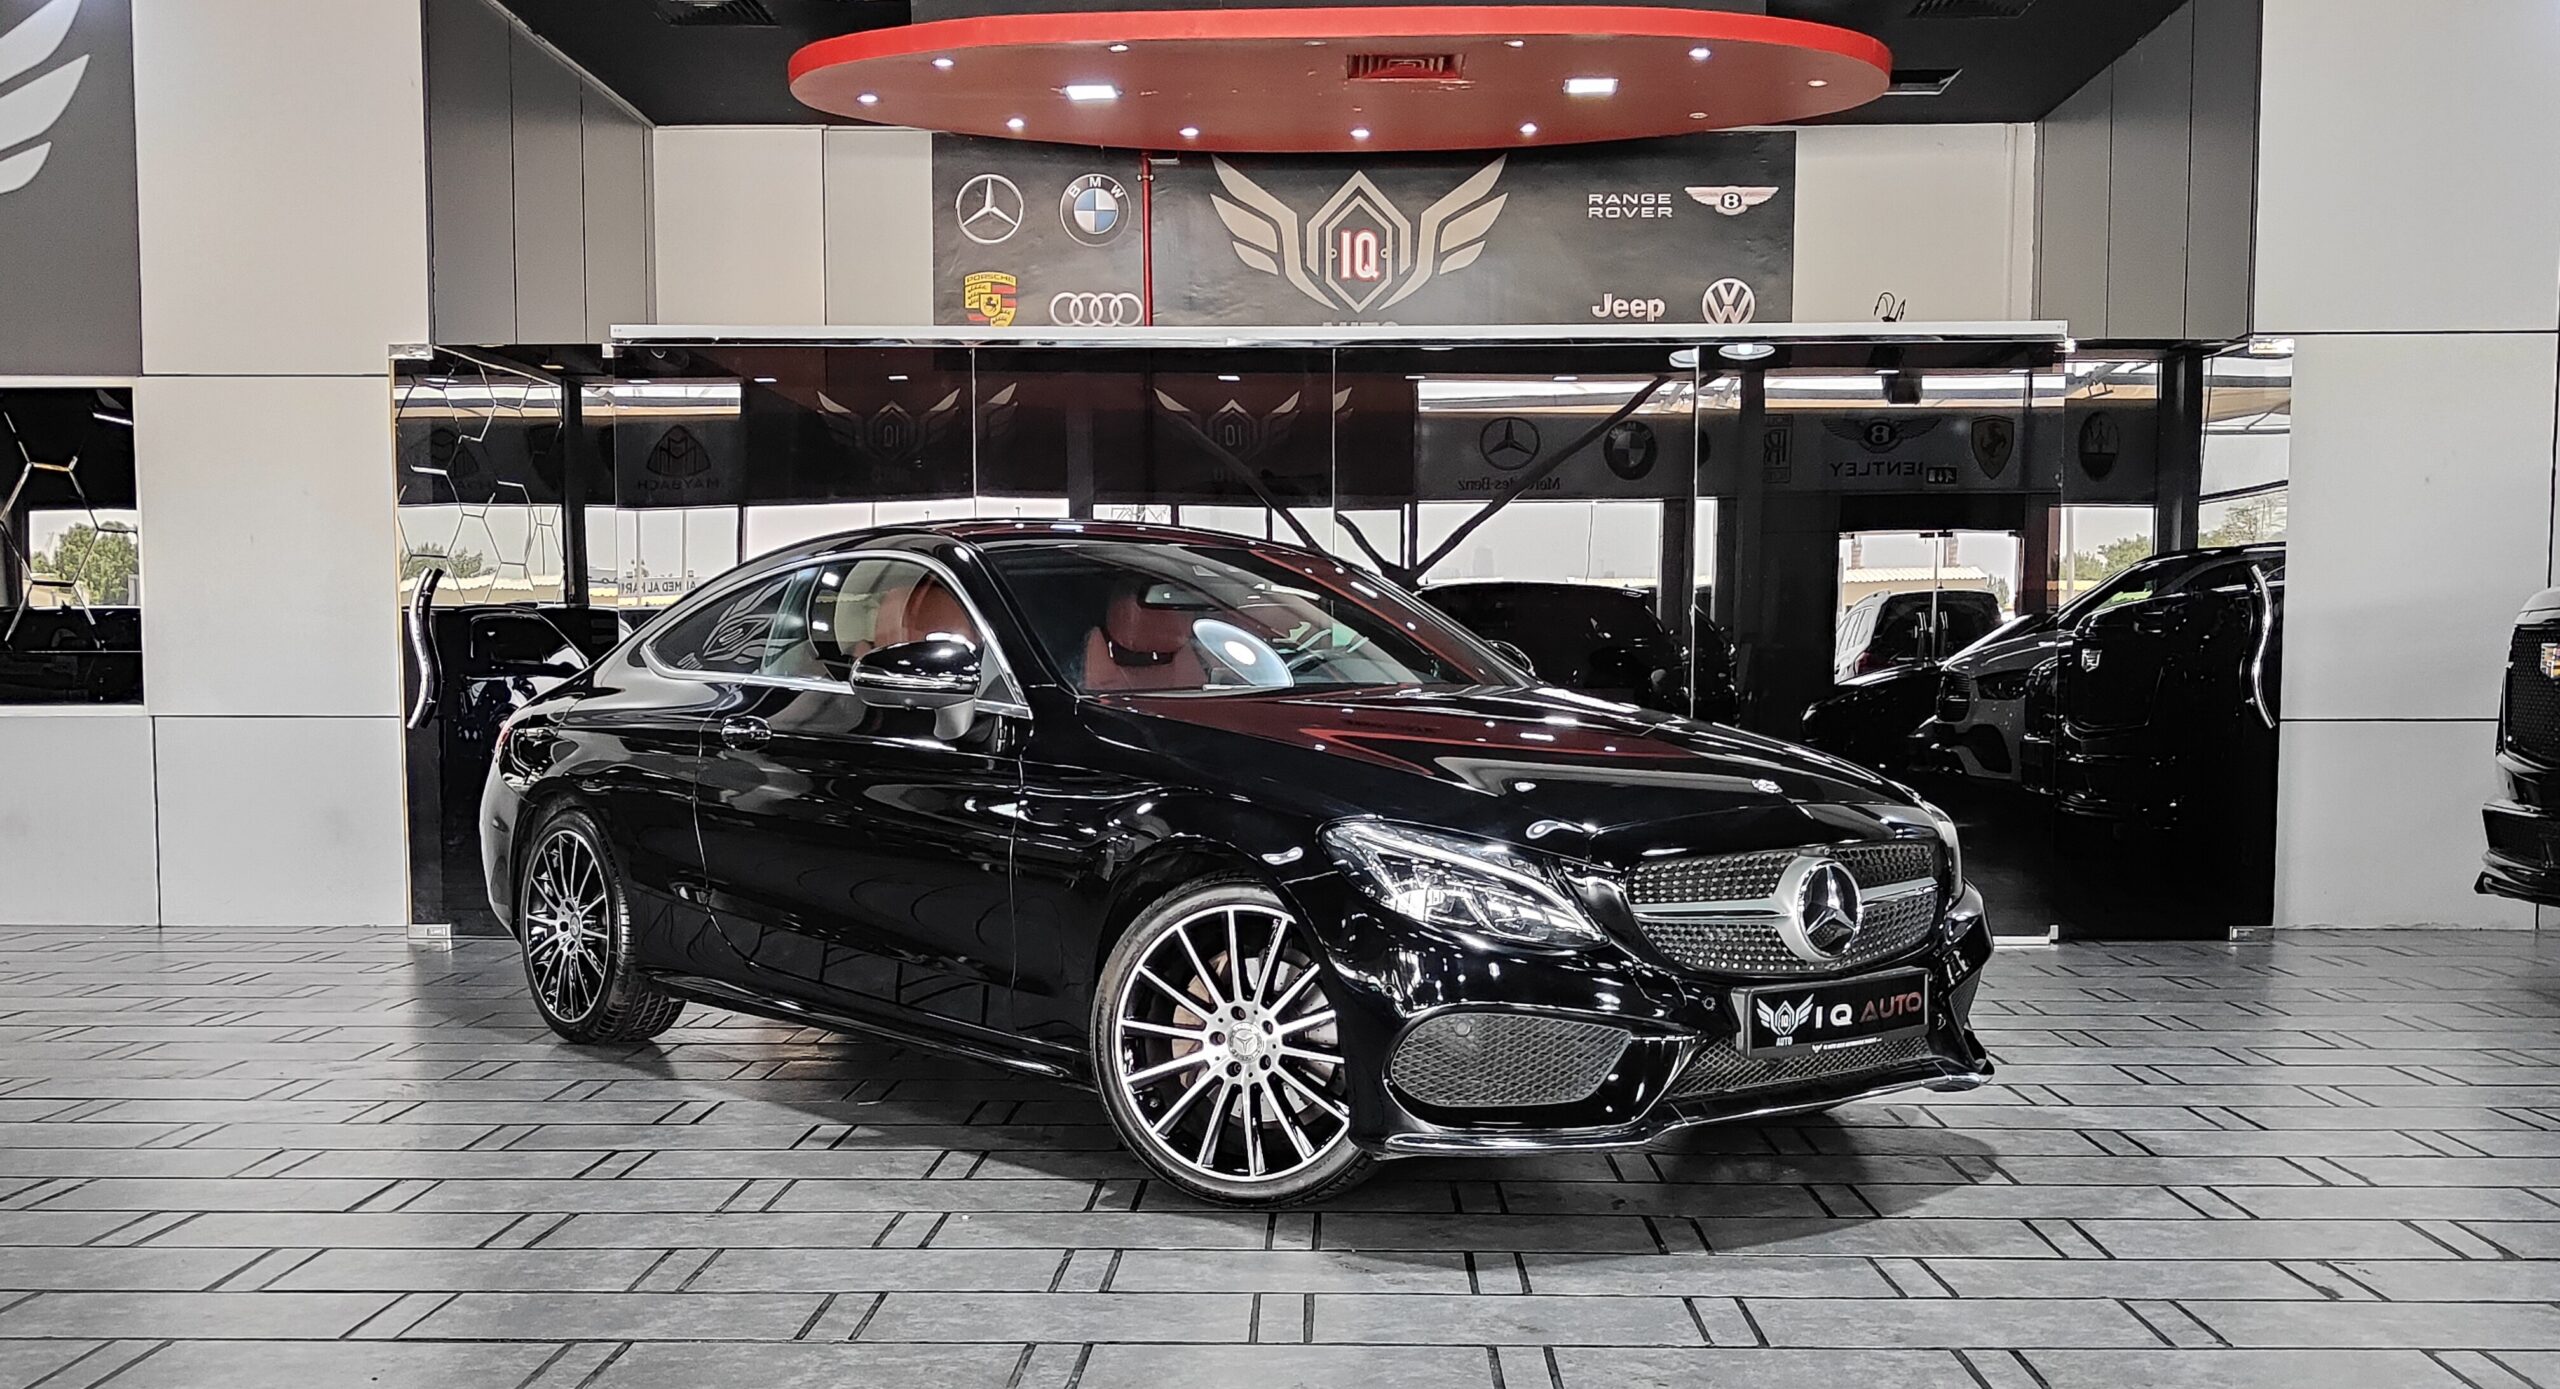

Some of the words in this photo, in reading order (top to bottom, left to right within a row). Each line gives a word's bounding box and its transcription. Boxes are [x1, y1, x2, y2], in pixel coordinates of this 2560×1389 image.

[1067, 175, 1125, 199] BMW
[1588, 193, 1672, 205] RANGE
[1723, 195, 1740, 209] B
[1588, 206, 1673, 218] ROVER
[1340, 230, 1380, 280] IQ
[966, 273, 1015, 284] PORSCHE
[1592, 293, 1666, 323] Jeep
[1859, 991, 1923, 1024] AUTO
[1775, 1036, 1793, 1047] AUTO
